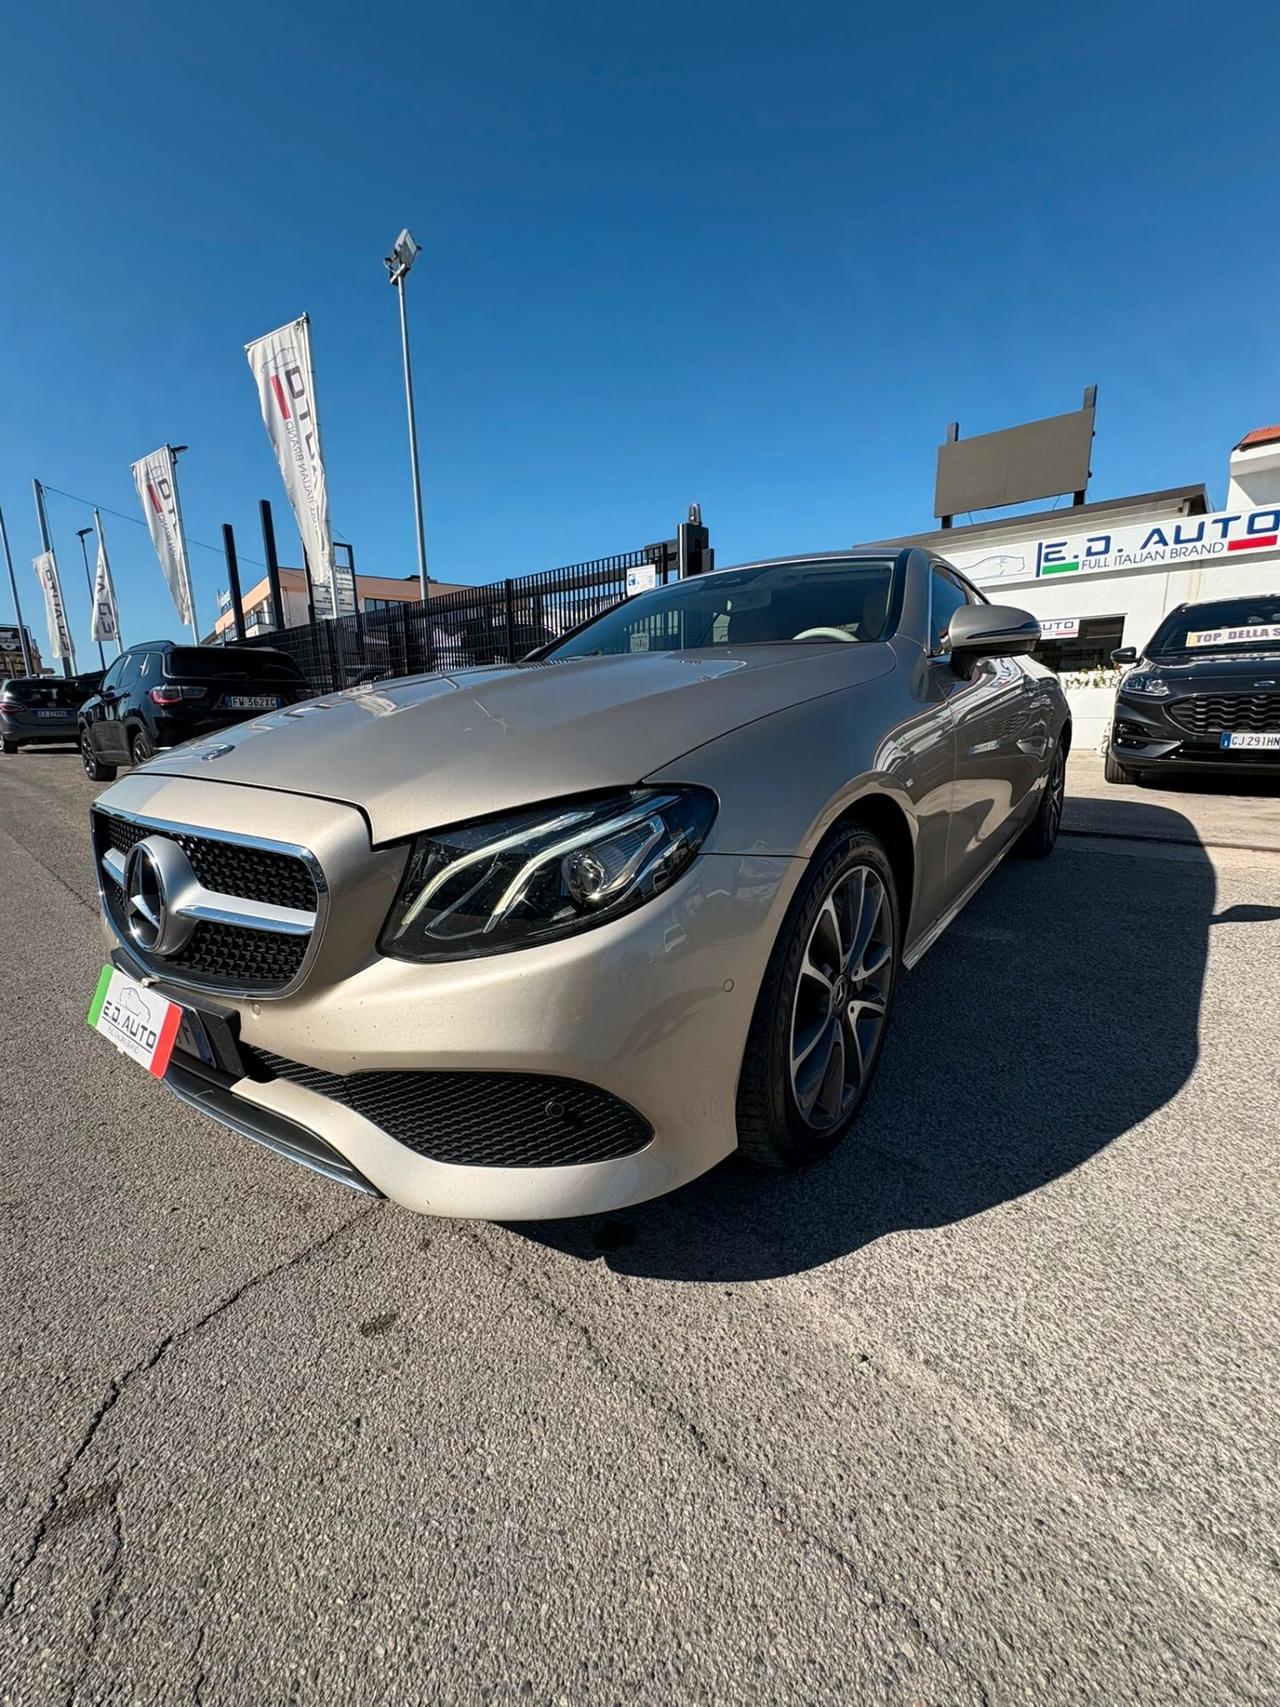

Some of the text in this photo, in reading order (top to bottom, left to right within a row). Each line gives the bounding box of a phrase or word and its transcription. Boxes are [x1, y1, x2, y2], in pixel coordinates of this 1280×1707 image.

[1043, 509, 1280, 563] E.D. AUTO
[1081, 541, 1226, 571] FULL ITALIAN BRAND
[1041, 621, 1075, 631] UTO
[1196, 632, 1222, 643] TOP
[1228, 628, 1270, 640] DELLA
[103, 1000, 121, 1026] E.D.
[121, 1015, 157, 1049] AUTO
